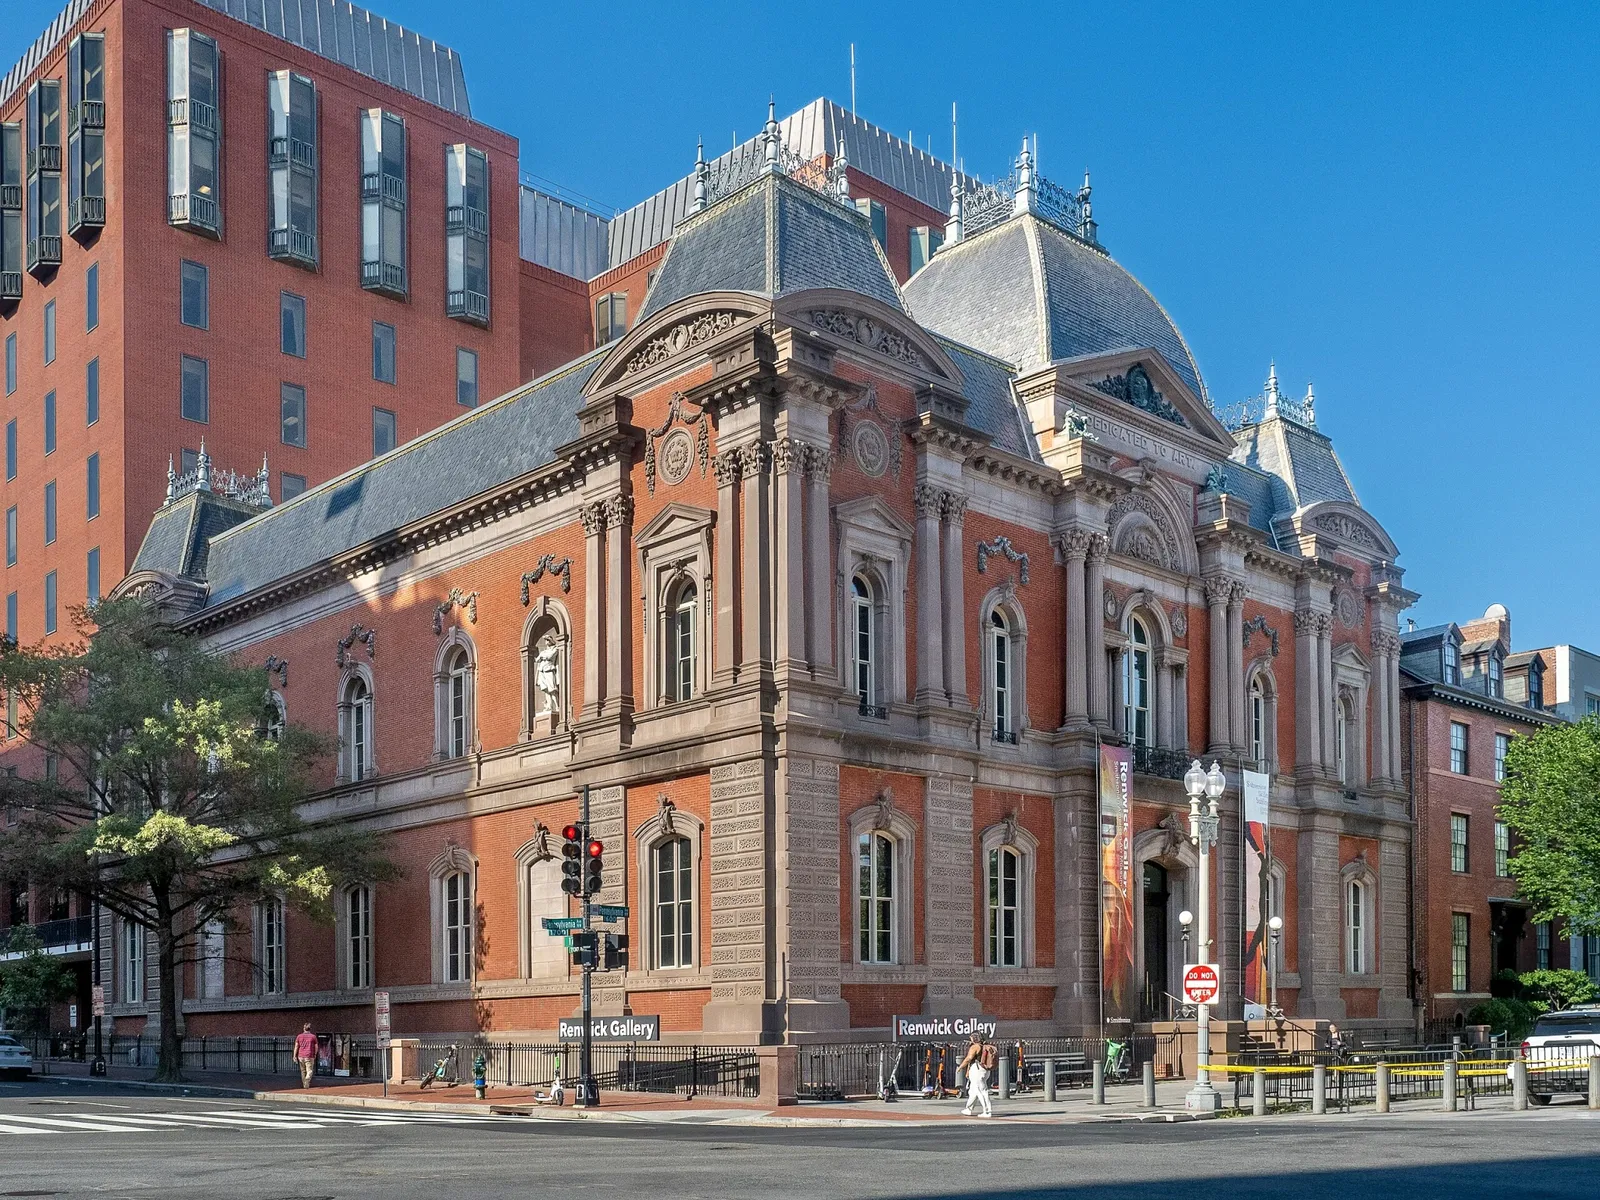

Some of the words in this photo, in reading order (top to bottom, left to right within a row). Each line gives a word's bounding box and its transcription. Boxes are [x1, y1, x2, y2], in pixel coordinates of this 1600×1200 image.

[1087, 414, 1149, 450] DEDICATED
[1153, 441, 1166, 457] TO
[1120, 761, 1129, 832] Renwick
[610, 1019, 654, 1040] Gallery
[899, 1018, 952, 1036] Renwick
[954, 1018, 996, 1038] Gallery
